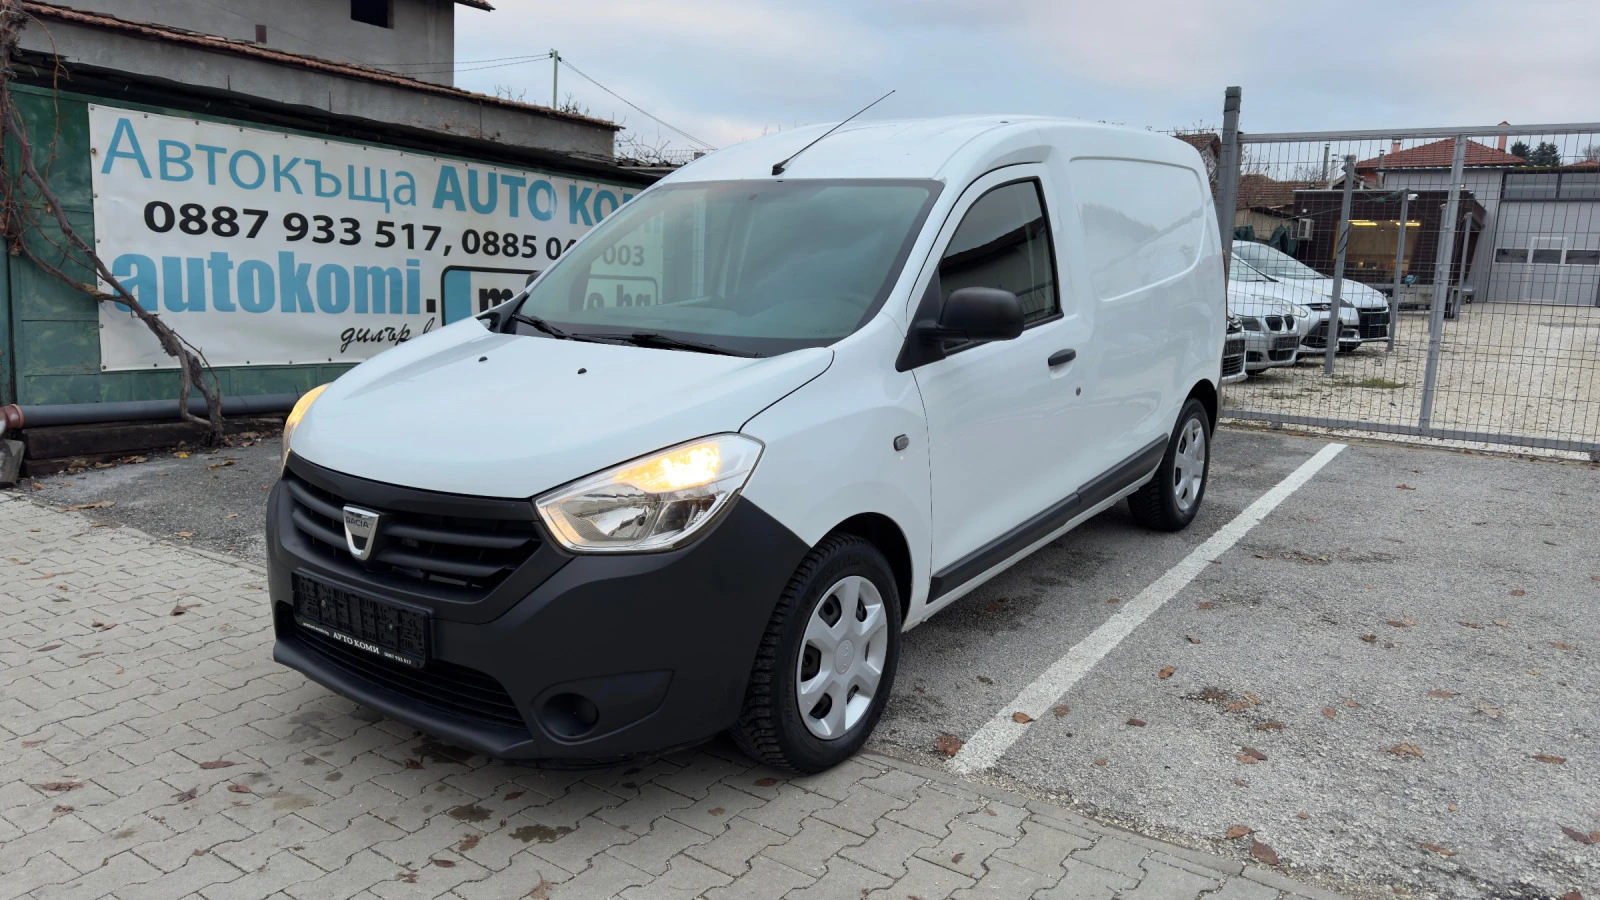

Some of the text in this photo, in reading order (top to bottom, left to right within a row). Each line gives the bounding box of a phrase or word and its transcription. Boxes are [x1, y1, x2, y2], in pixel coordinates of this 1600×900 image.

[101, 117, 417, 214] Автокъща
[432, 165, 558, 222] AUTO
[144, 200, 269, 239] 0887
[282, 212, 362, 246] 933
[374, 220, 453, 257] 517,
[461, 228, 538, 259] 0885
[345, 515, 370, 529] DACIA
